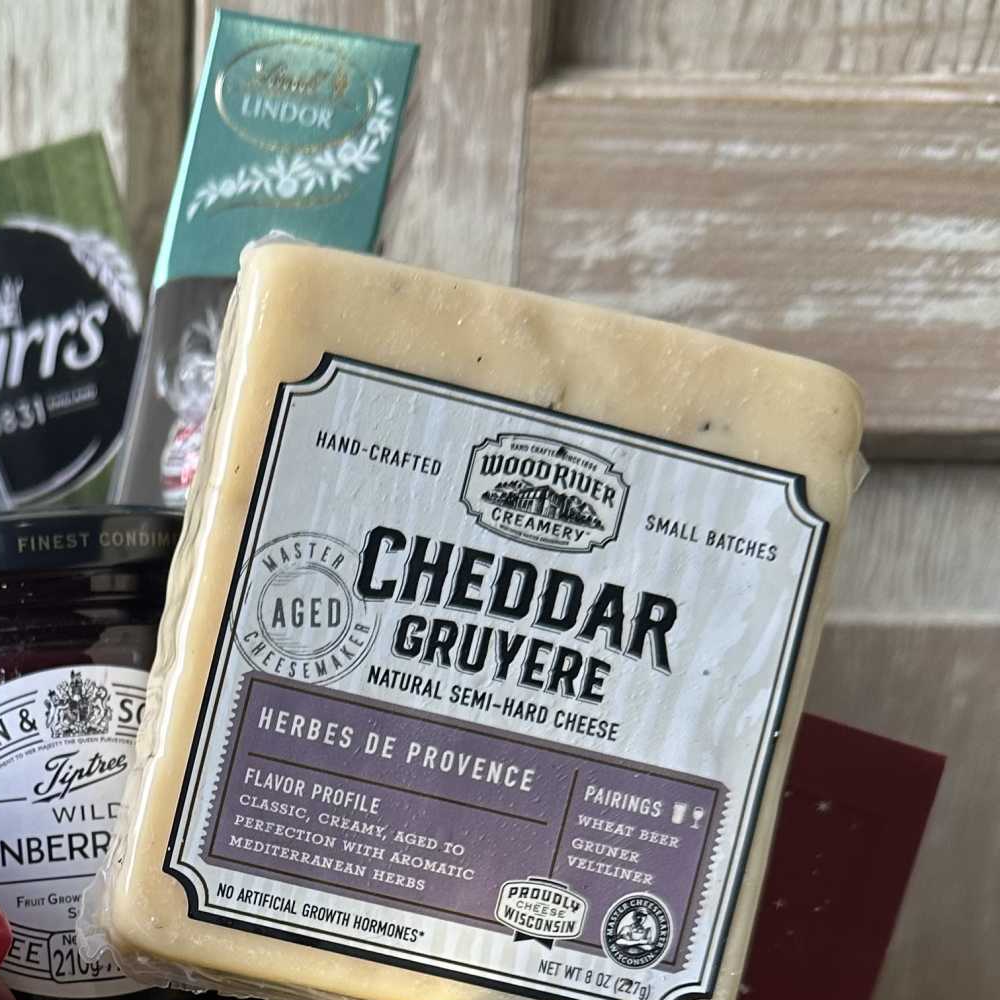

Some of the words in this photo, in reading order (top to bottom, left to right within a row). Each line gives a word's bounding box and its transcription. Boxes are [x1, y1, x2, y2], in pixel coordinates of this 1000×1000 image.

[241, 95, 334, 130] LINDOR
[315, 430, 443, 477] HAND-CRAFTED
[491, 506, 586, 542] CREAMERY
[645, 513, 700, 543] SMALL
[706, 530, 779, 563] BATCHES
[16, 532, 91, 554] FINEST
[261, 541, 346, 574] MASTER
[271, 597, 342, 629] AGED
[354, 525, 679, 676] CHEDDAR
[243, 622, 371, 679] CHEESEMAKER
[391, 613, 612, 705] GRUYERE
[18, 708, 38, 733] &
[366, 665, 444, 700] NATURAL
[448, 684, 550, 726] SEMI-HARD
[553, 710, 622, 743] CHEESE
[257, 706, 355, 751] HERBES
[364, 731, 398, 760] DE
[405, 741, 537, 794] PROVENCE
[32, 750, 128, 800] Tiptree
[243, 767, 306, 798] FLAVOR
[311, 783, 382, 816] PROFILE
[583, 785, 664, 819] PAIRINGS
[238, 793, 312, 824] CLASSIC,
[317, 812, 390, 842] CREAMY,
[392, 829, 439, 851] AGED
[443, 841, 466, 858] TO
[577, 813, 636, 838] WHEAT
[638, 827, 681, 850] BEER
[228, 834, 367, 879] MEDITERRANEAN
[371, 868, 427, 892] HERBS
[233, 813, 337, 850] PERFECTION
[342, 838, 387, 862] WITH
[388, 851, 477, 882] AROMATIC
[570, 837, 642, 865] GRUNER
[566, 855, 656, 887] VELTLINER
[216, 882, 235, 900] NO
[236, 887, 299, 917] ARTIFICIAL
[301, 902, 352, 929] GROWTH
[507, 885, 582, 914] PROUDLY
[514, 901, 567, 920] CHEESE
[502, 903, 577, 934] WISCONSIN
[605, 902, 630, 937] MASTER
[608, 942, 656, 966] WISCONSIN
[537, 958, 562, 978] NET
[563, 964, 583, 983] WT
[584, 969, 593, 985] 8
[595, 971, 612, 989] OZ
